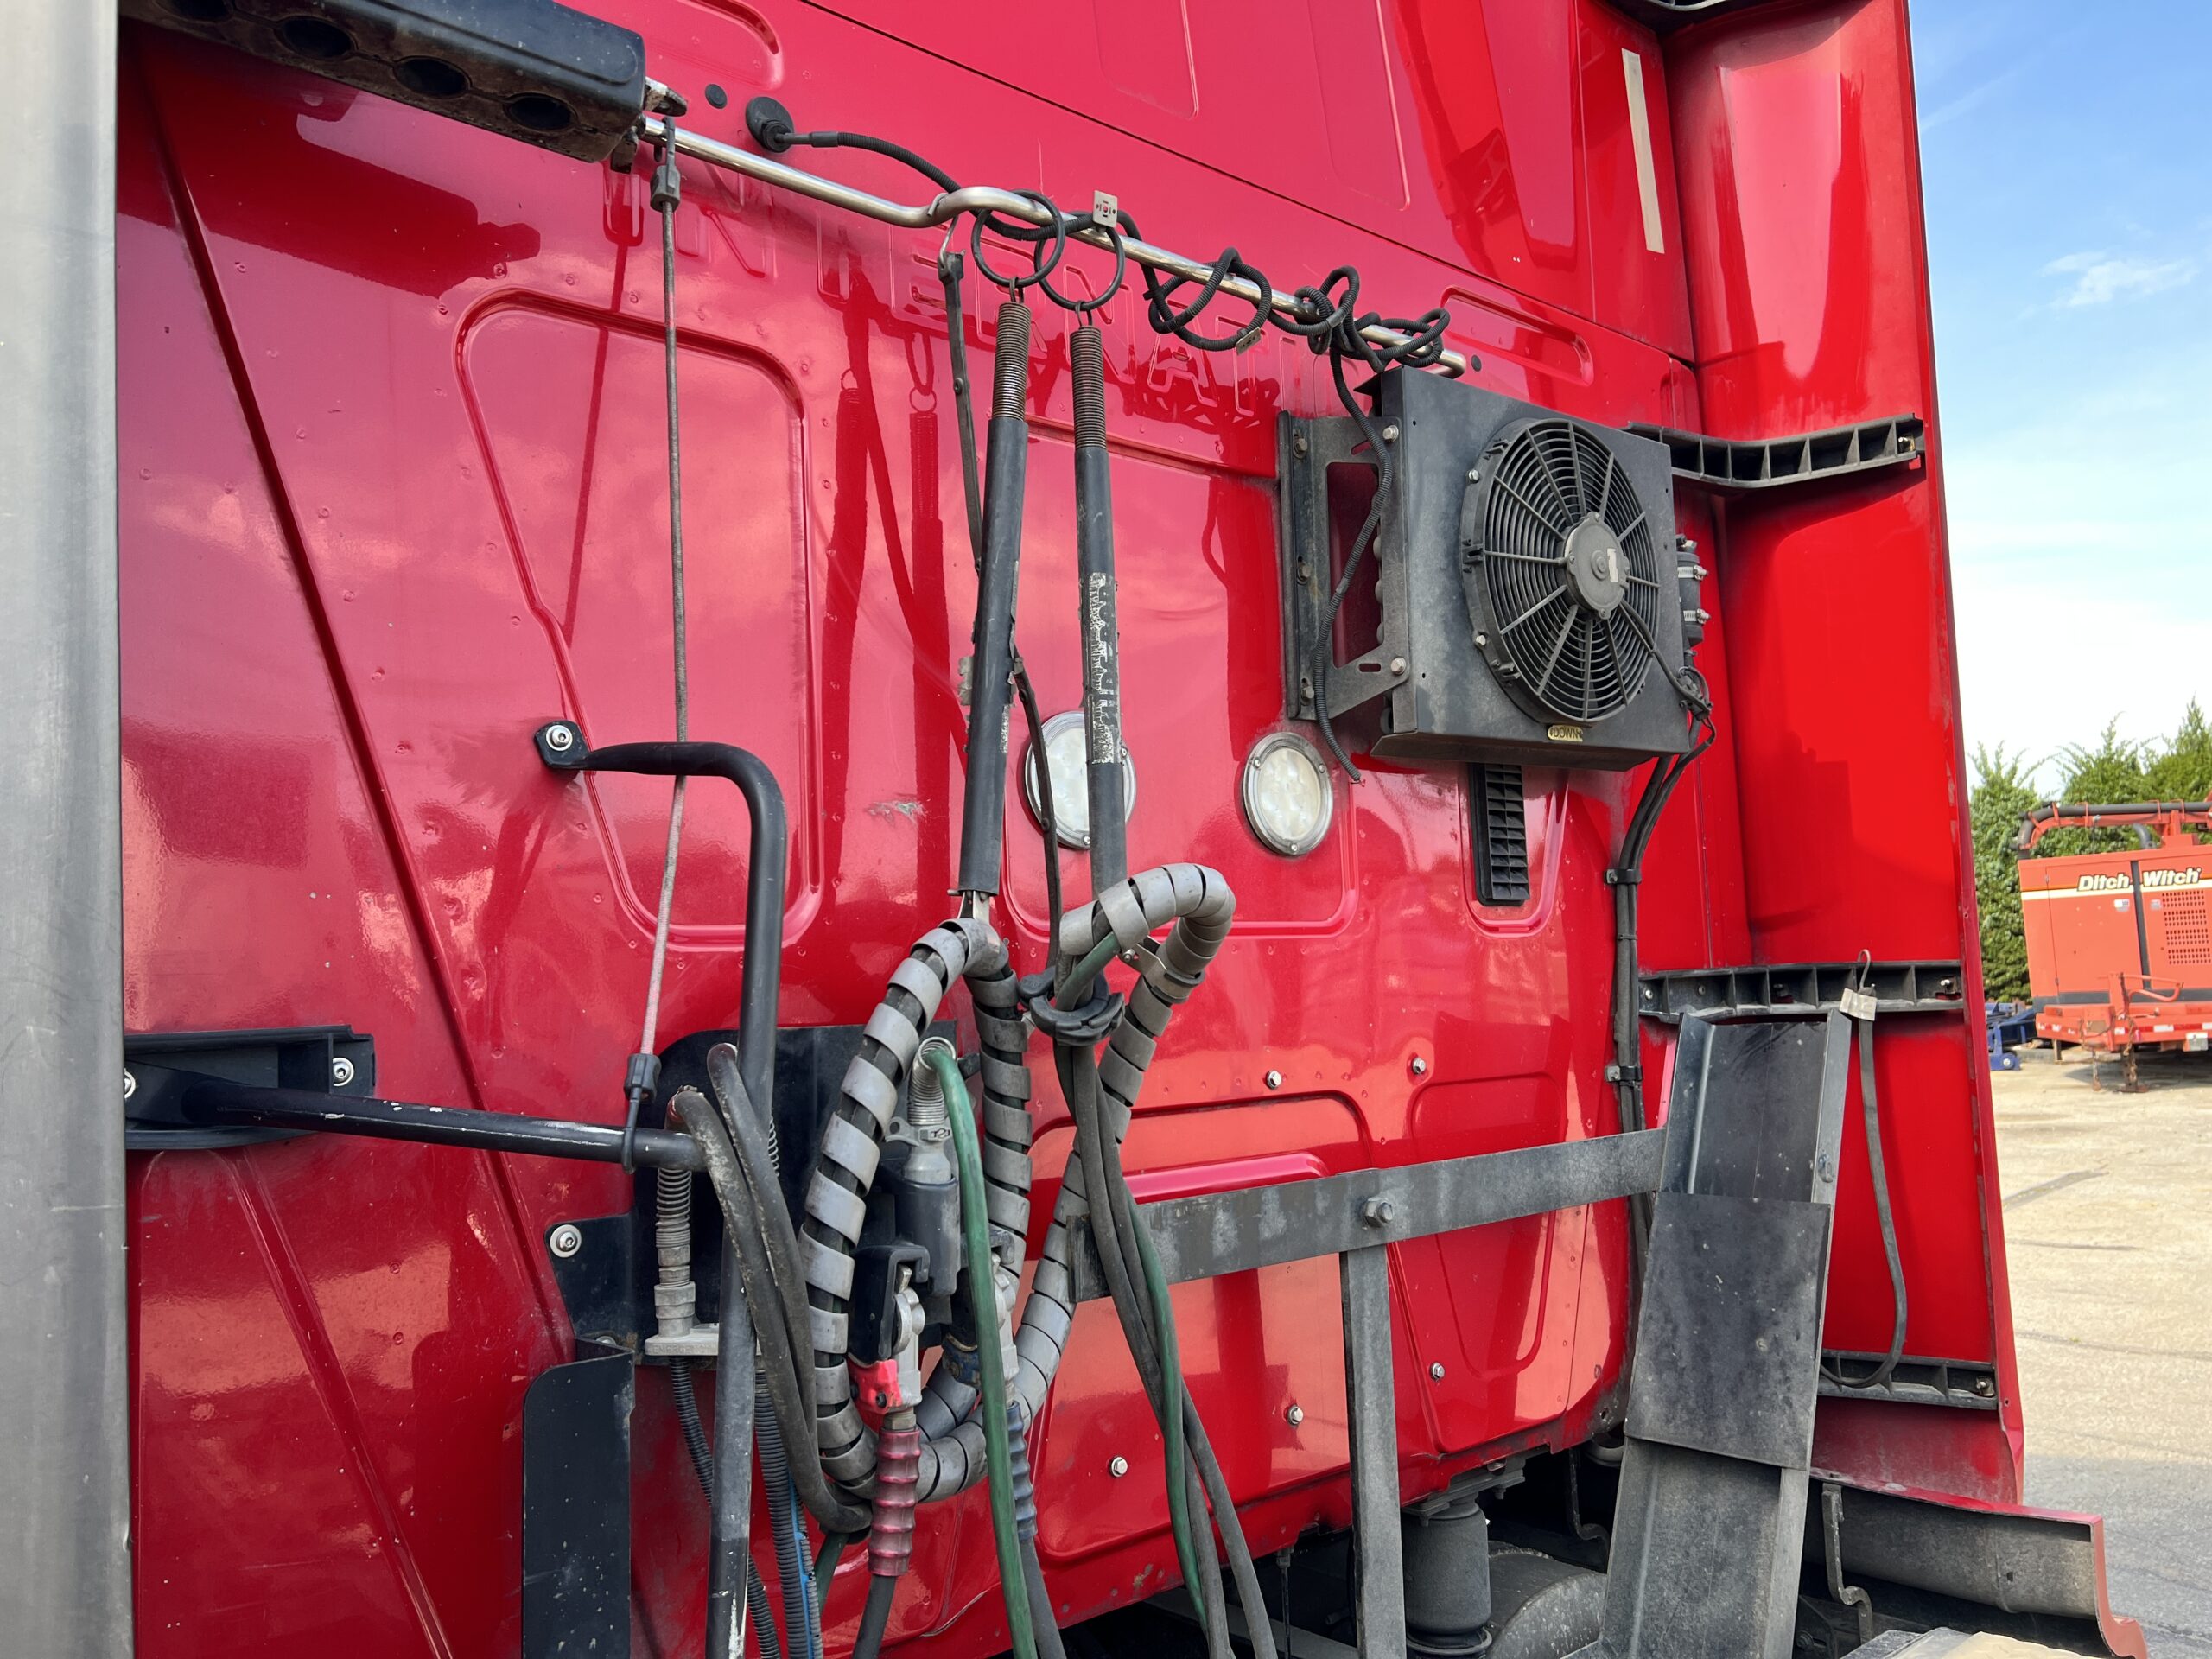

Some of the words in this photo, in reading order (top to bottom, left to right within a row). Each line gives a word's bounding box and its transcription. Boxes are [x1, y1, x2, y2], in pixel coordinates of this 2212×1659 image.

[602, 162, 1350, 419] INTERNATIO
[2077, 872, 2130, 892] Ditch
[2143, 868, 2200, 887] Witch
